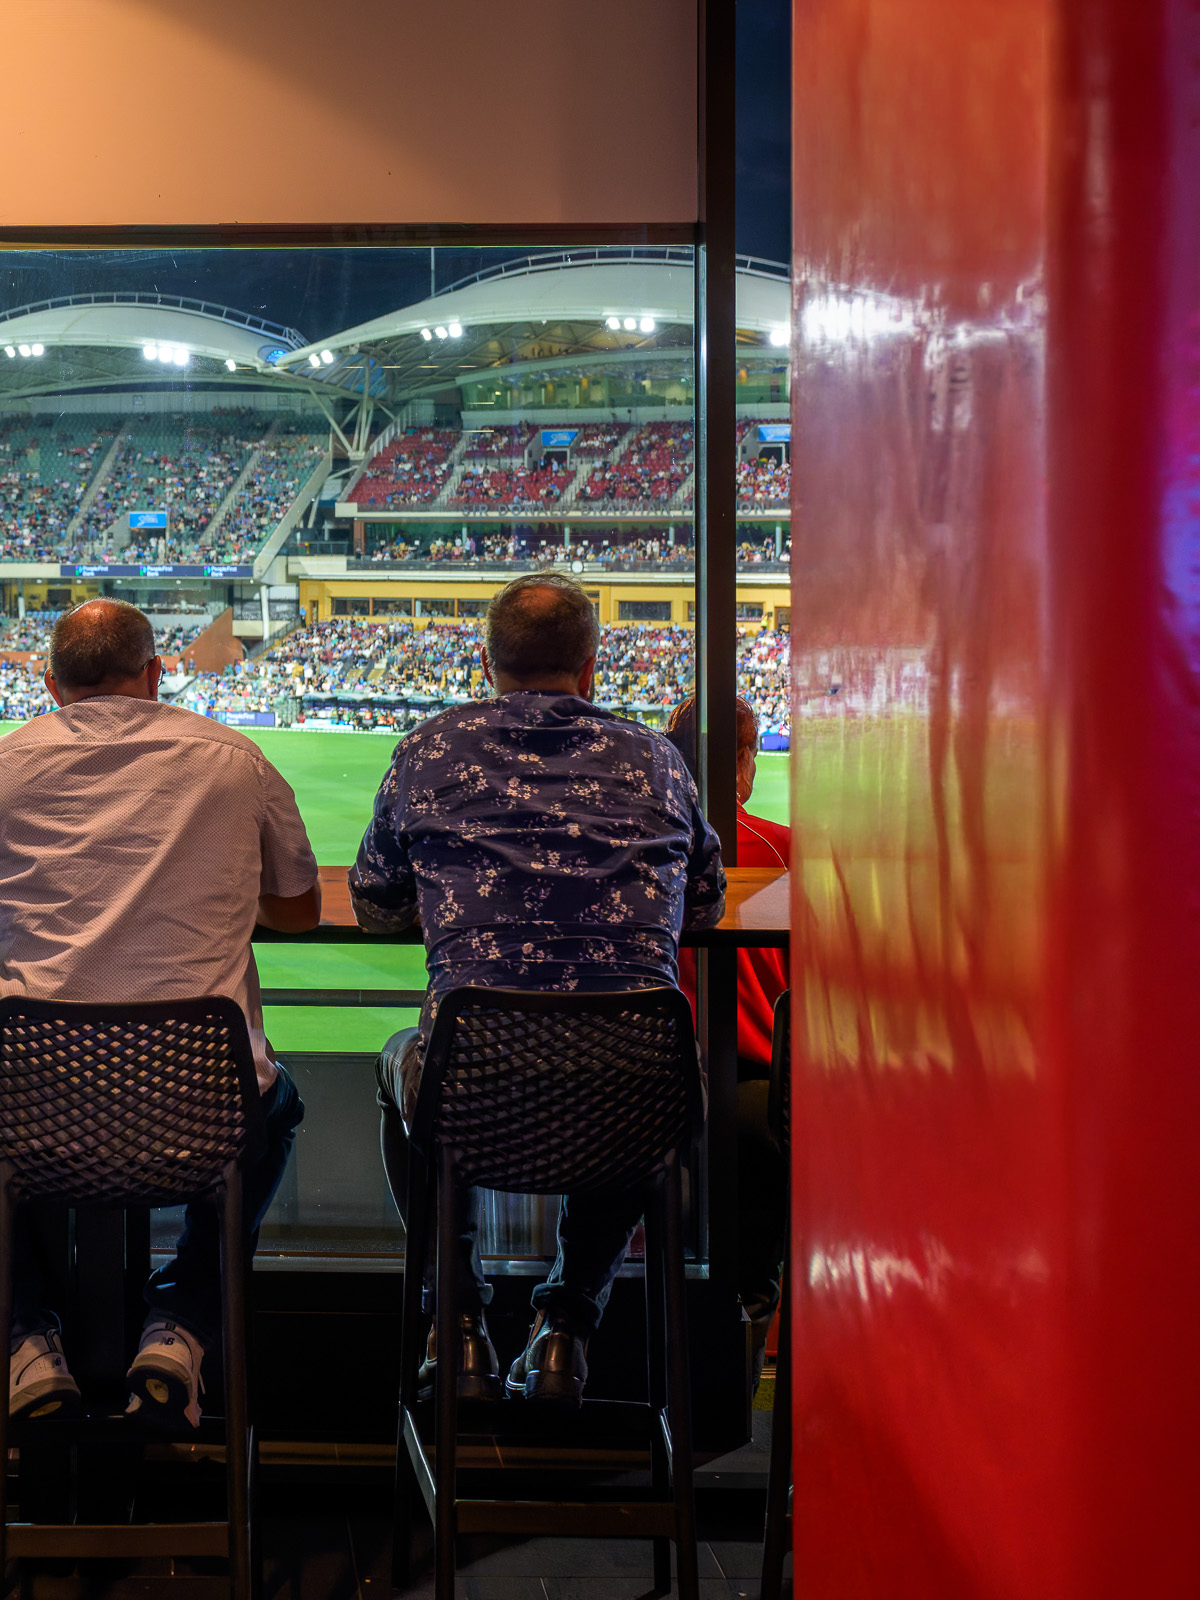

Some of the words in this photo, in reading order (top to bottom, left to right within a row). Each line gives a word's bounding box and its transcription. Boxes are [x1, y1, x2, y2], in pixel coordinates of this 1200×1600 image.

[462, 503, 489, 516] SIR
[499, 502, 570, 516] DONALD
[581, 502, 670, 516] BRADMAN
